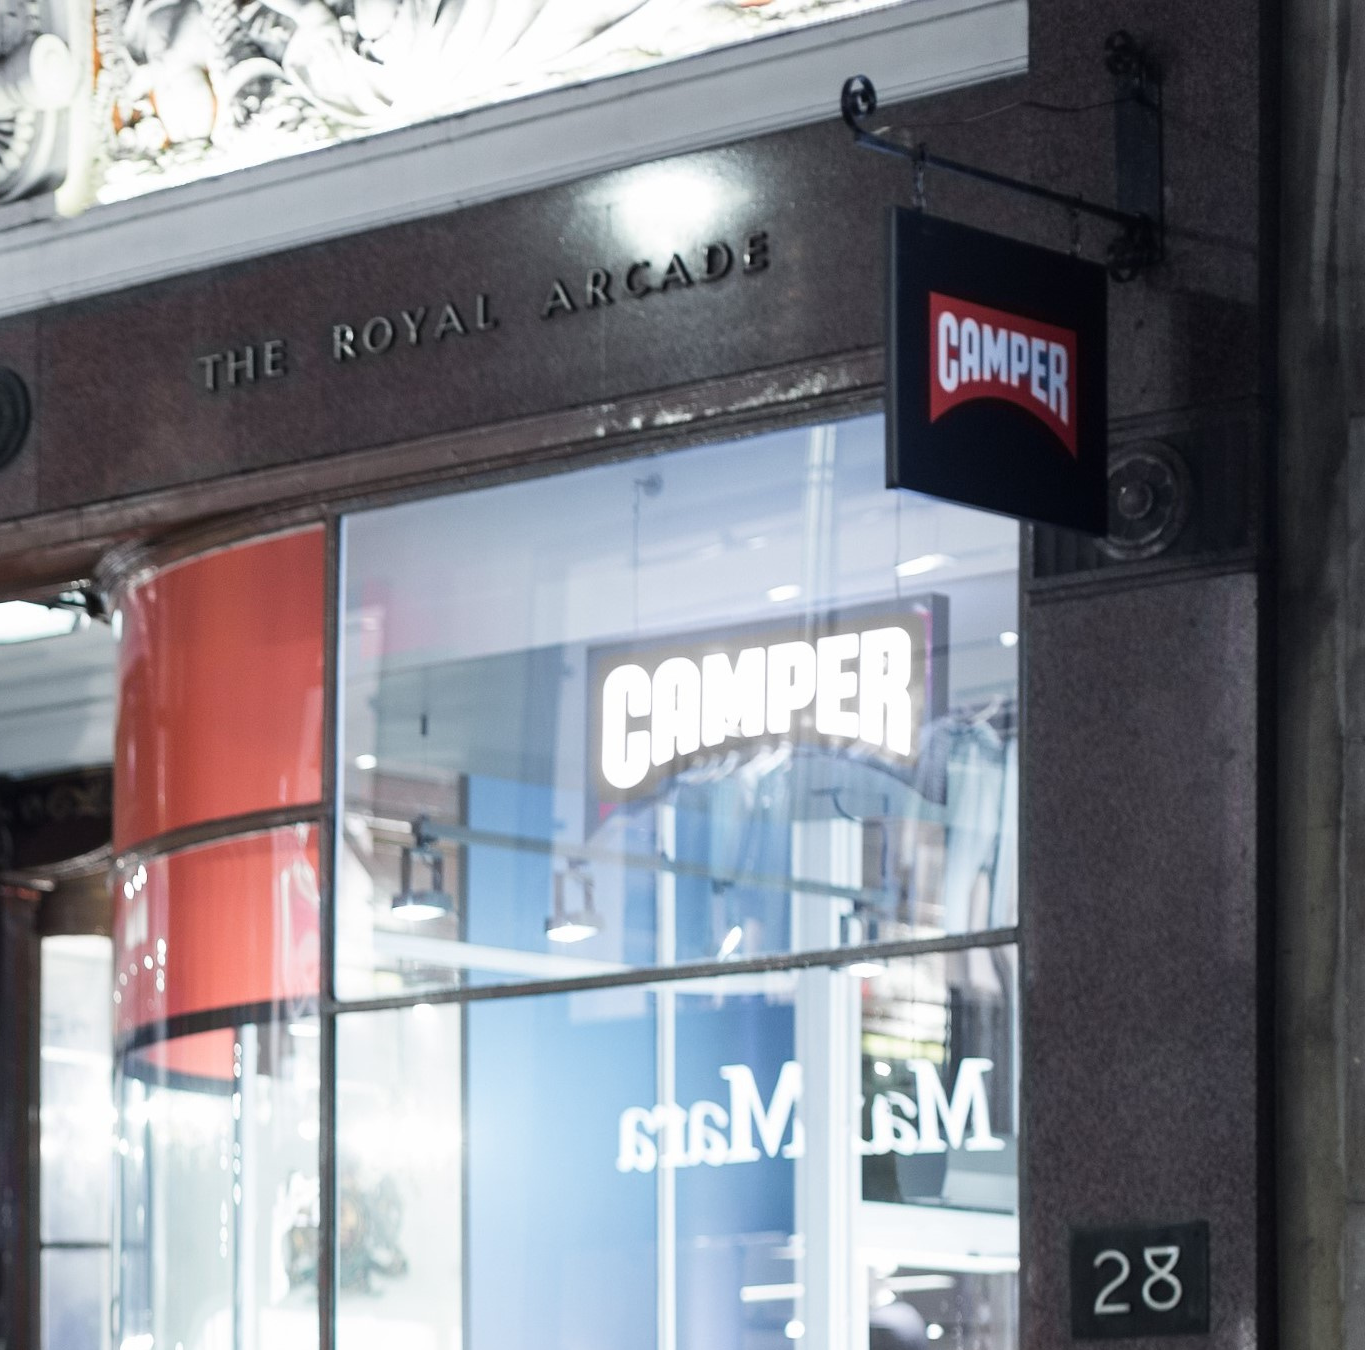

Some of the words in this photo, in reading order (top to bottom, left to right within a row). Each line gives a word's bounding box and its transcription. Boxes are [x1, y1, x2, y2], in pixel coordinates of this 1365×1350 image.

[196, 339, 287, 391] THE
[332, 293, 499, 362] ROYAL
[540, 231, 770, 320] ARCADE
[938, 311, 1068, 426] CAMPER
[602, 626, 911, 789] CAMPER
[1093, 1245, 1182, 1315] 28
